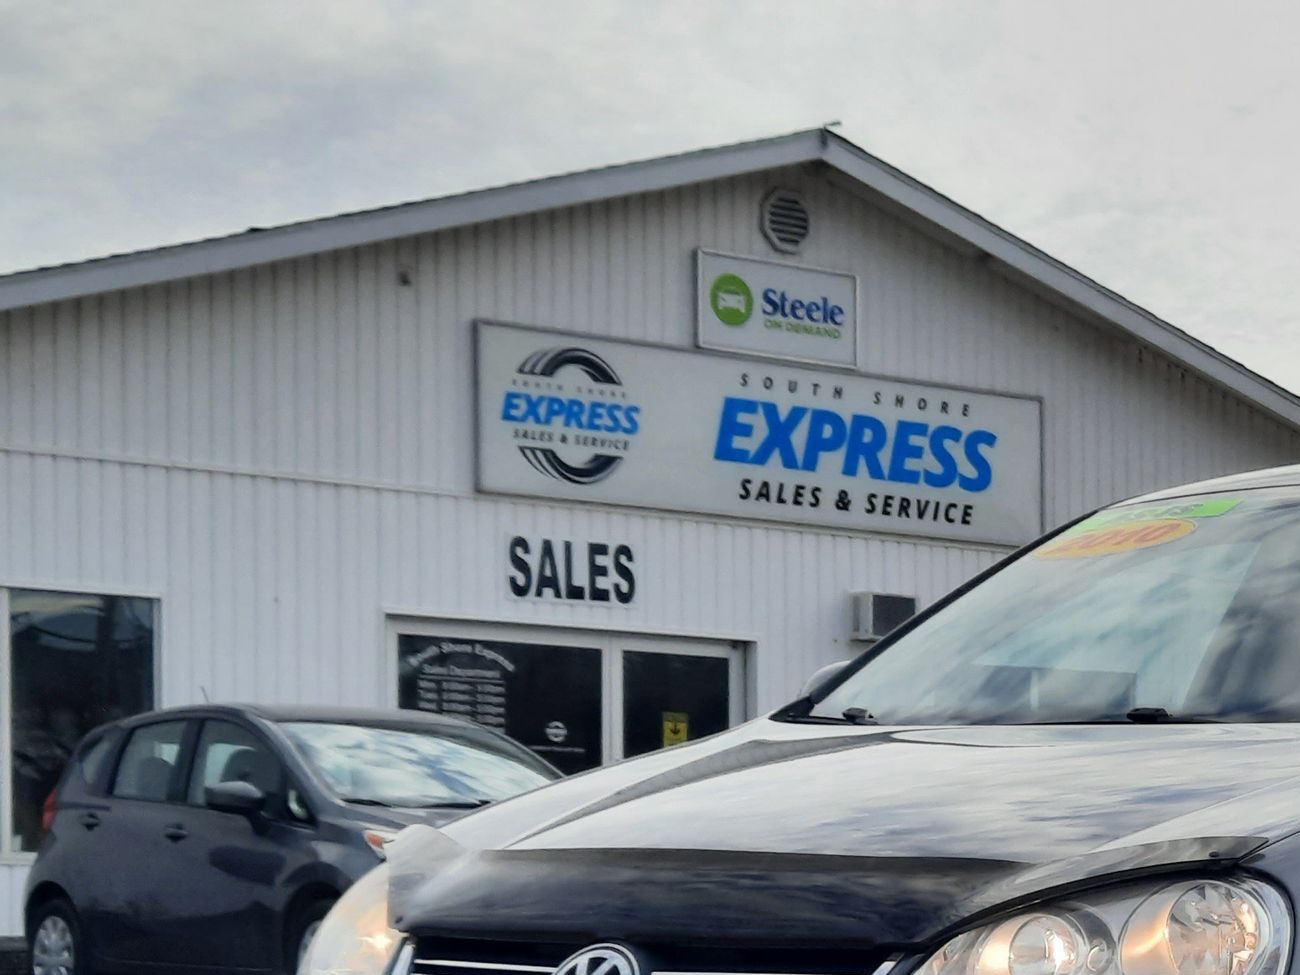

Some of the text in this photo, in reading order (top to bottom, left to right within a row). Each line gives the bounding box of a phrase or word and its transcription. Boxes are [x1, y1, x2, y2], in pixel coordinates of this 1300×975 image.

[762, 288, 845, 326] Steele
[502, 391, 640, 435] EXPRESS
[740, 373, 970, 417] SOUTH SHORE
[513, 428, 553, 446] SALES
[575, 434, 629, 451] SERVICE
[713, 396, 997, 493] EXPRESS
[738, 478, 974, 525] SALES & SERVICE
[509, 536, 635, 604] SALES
